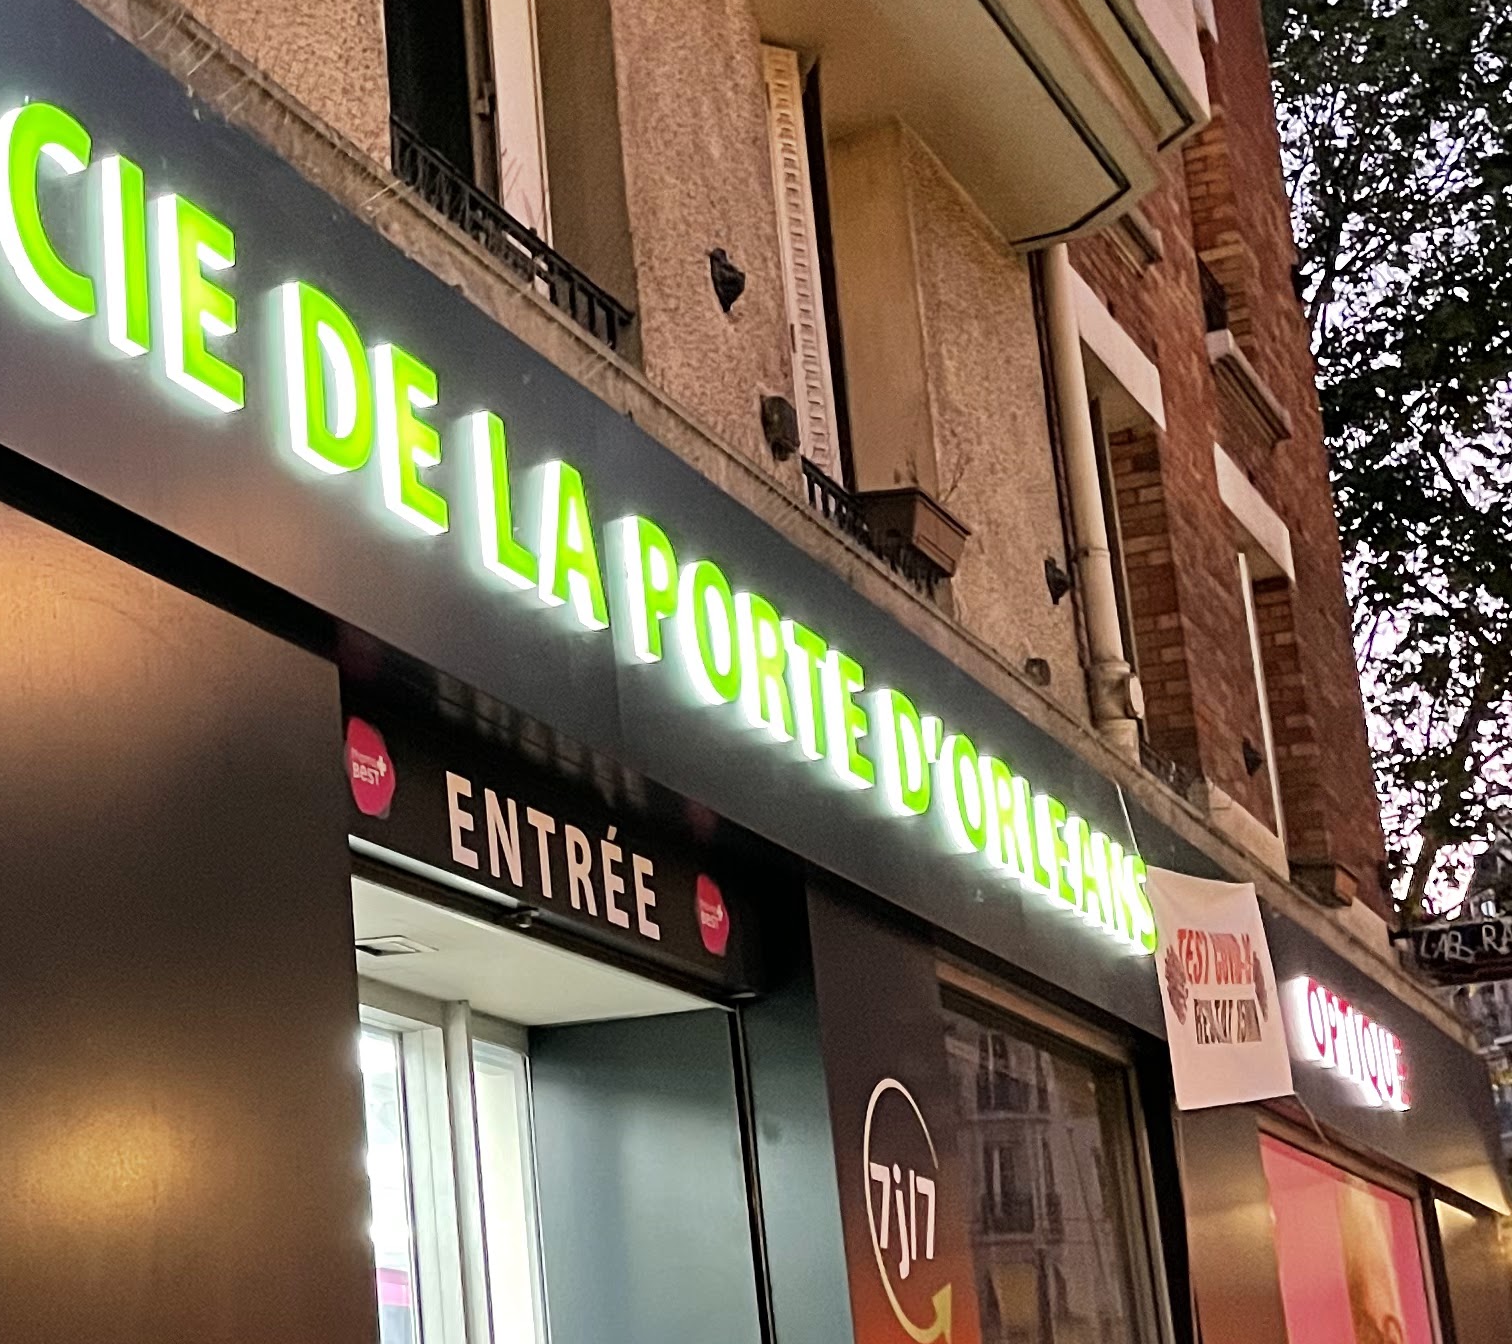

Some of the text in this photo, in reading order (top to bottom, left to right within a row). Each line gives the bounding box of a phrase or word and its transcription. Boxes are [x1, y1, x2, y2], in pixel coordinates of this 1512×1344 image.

[282, 280, 449, 535] DE
[472, 410, 610, 631] LA
[622, 514, 874, 789] PORTE
[446, 770, 661, 940] ENTRÉE
